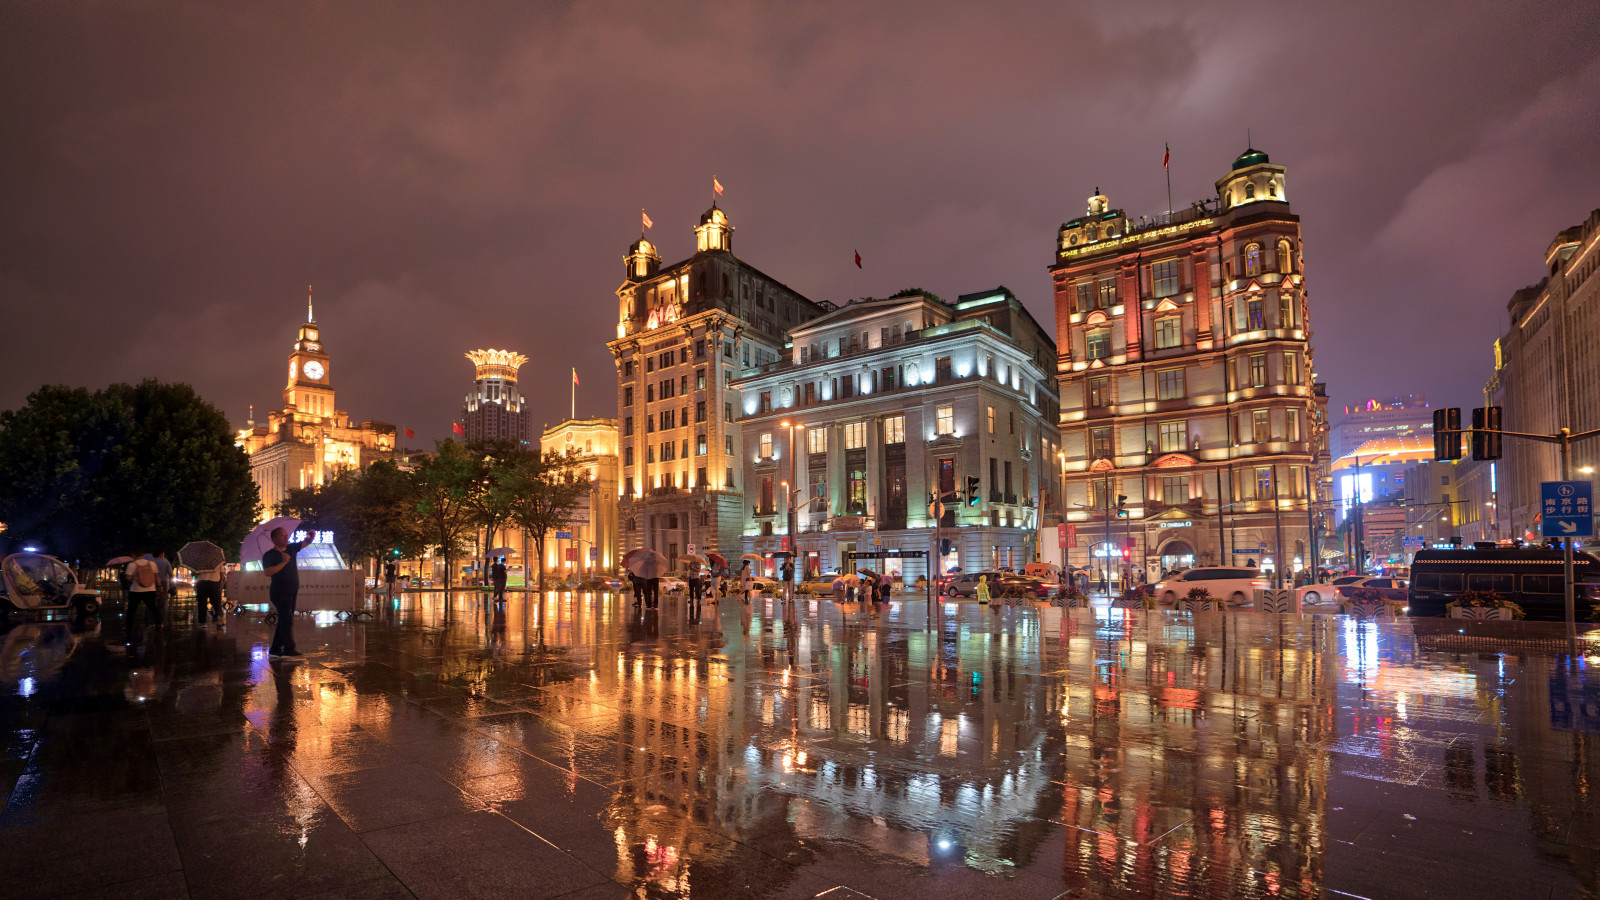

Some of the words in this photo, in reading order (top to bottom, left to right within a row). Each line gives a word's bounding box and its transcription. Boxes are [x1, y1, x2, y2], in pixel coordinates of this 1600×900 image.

[1121, 234, 1142, 244] ART
[1143, 226, 1177, 239] PEACE
[1179, 218, 1214, 231] HOTEL
[647, 303, 677, 329] AIA
[1545, 498, 1588, 506] 南京路
[1545, 506, 1588, 514] 步行街
[1094, 549, 1122, 557] OMGA
